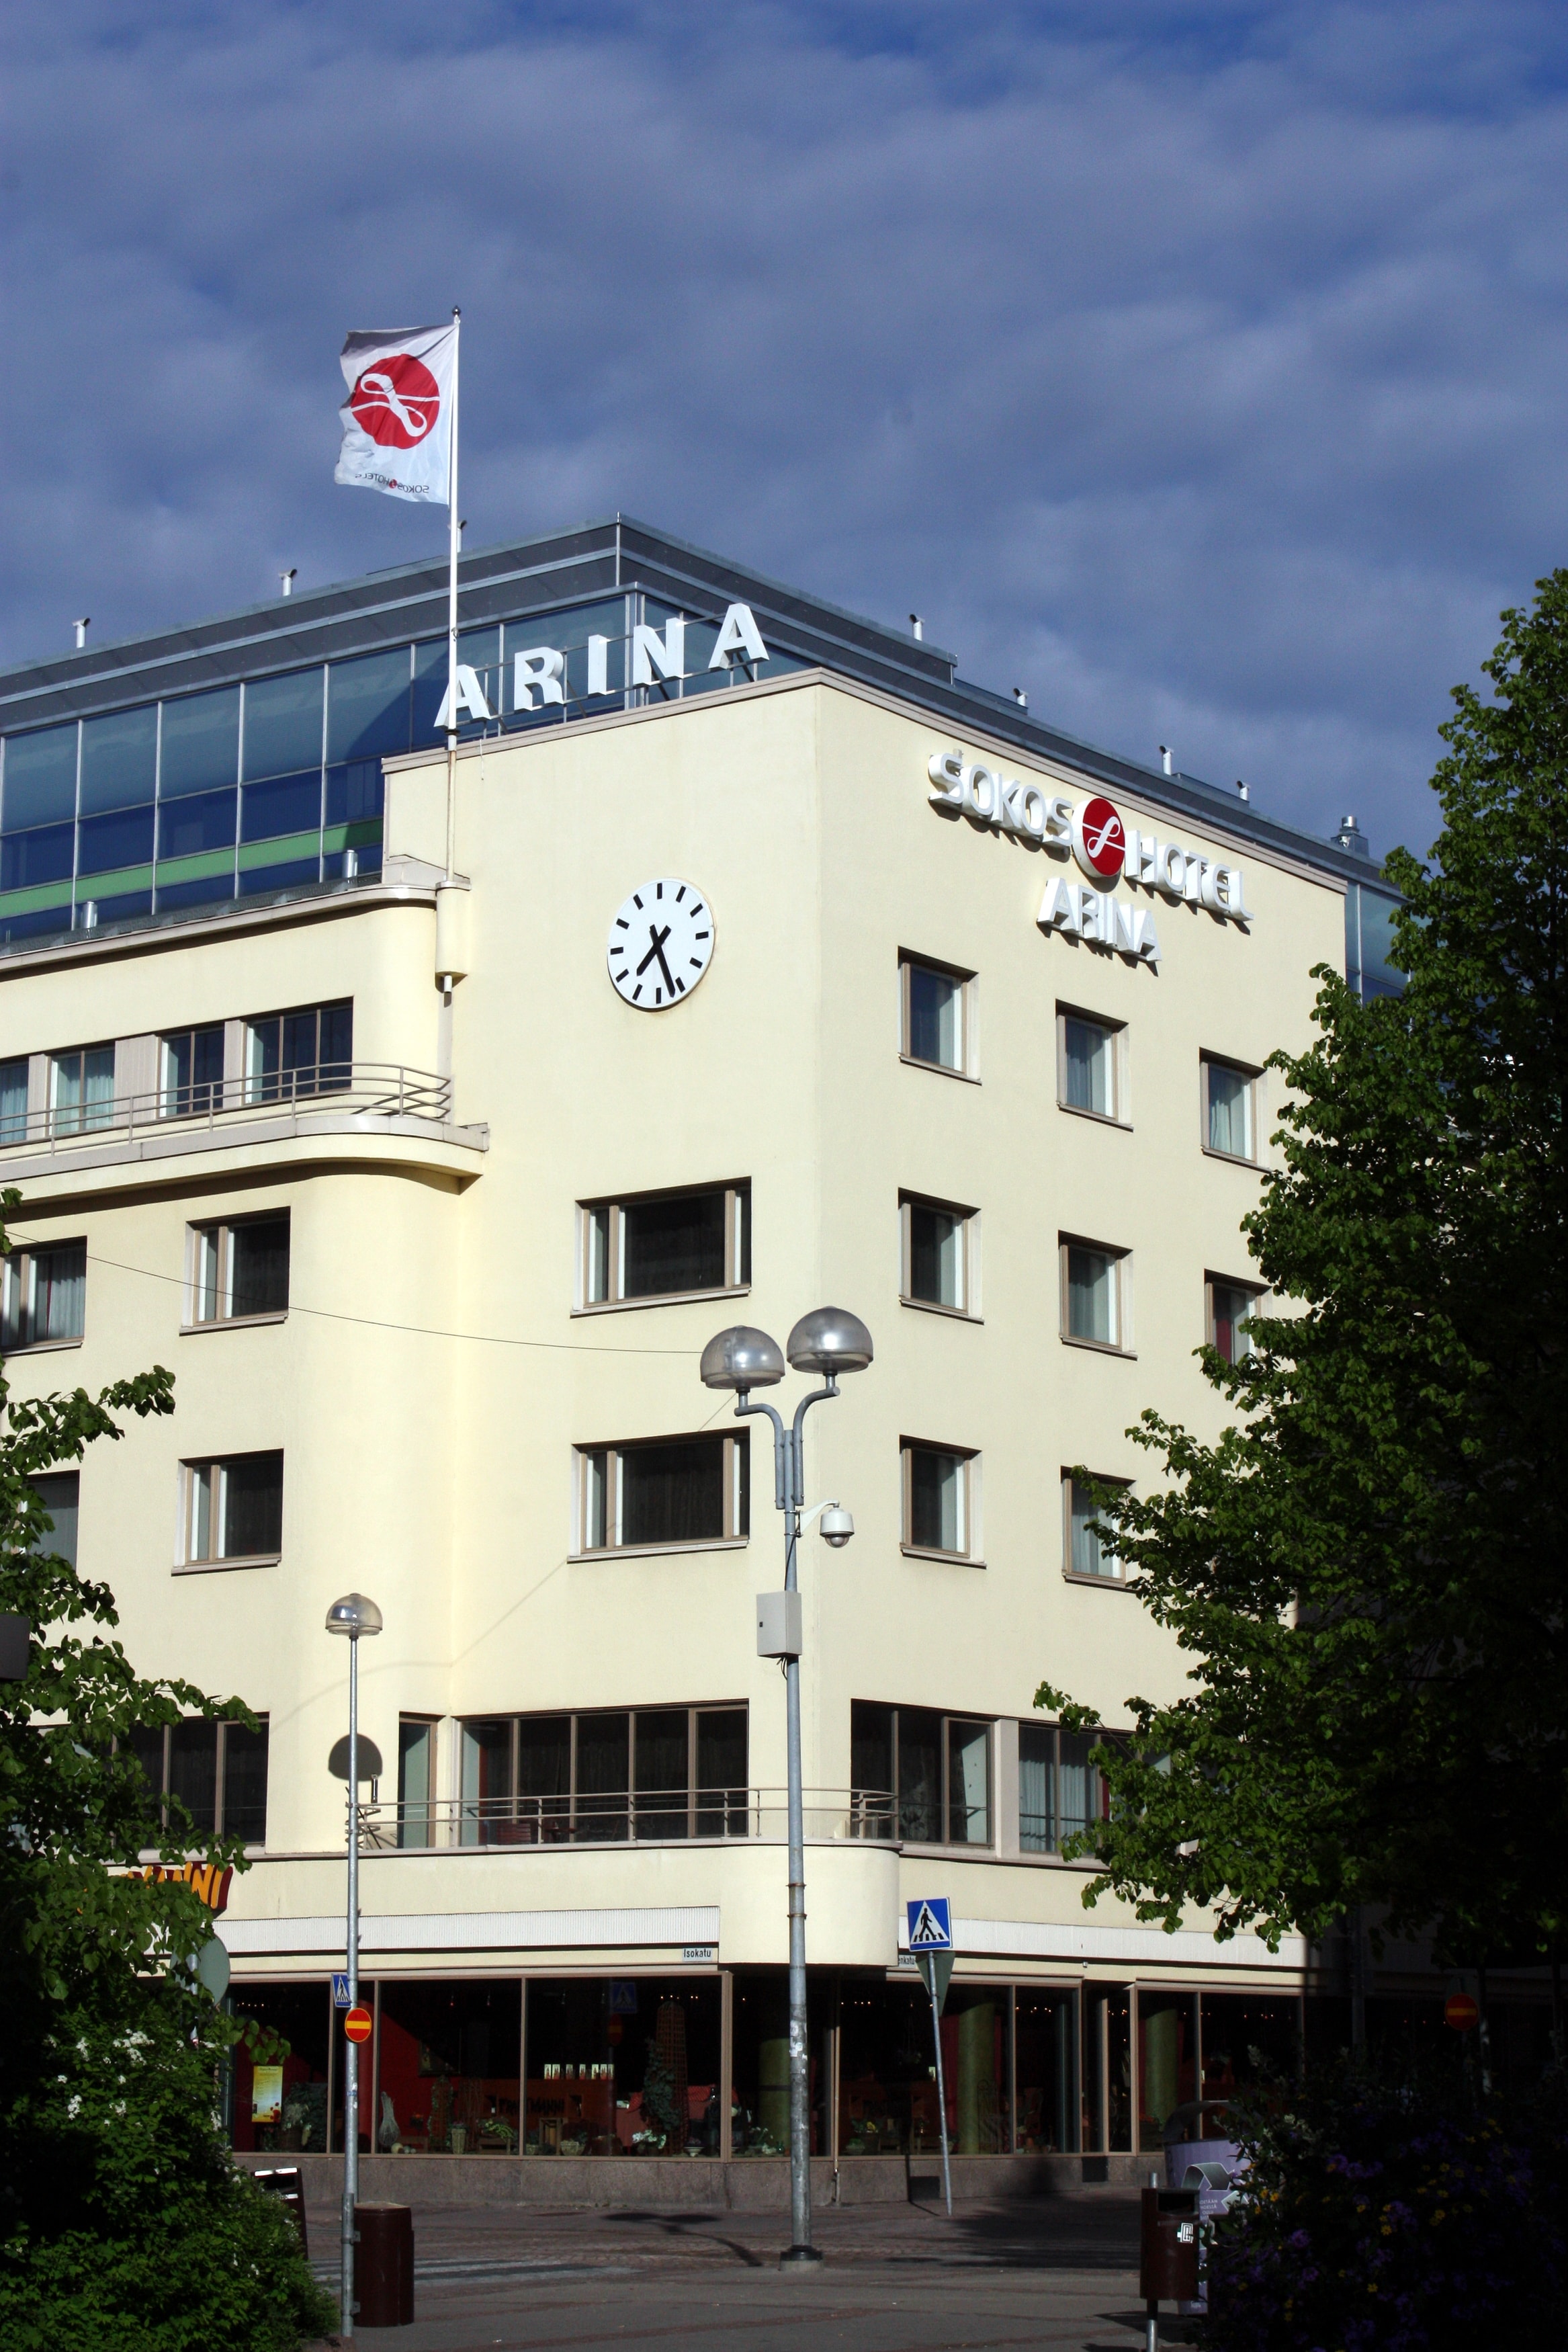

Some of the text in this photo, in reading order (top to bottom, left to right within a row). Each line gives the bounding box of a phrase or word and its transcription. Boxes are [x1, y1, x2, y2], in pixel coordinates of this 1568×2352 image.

[433, 602, 770, 728] ARINA
[928, 752, 1254, 921] SOKOS HOTEL
[1037, 878, 1162, 962] ARINA
[684, 1948, 711, 1958] Isokatu
